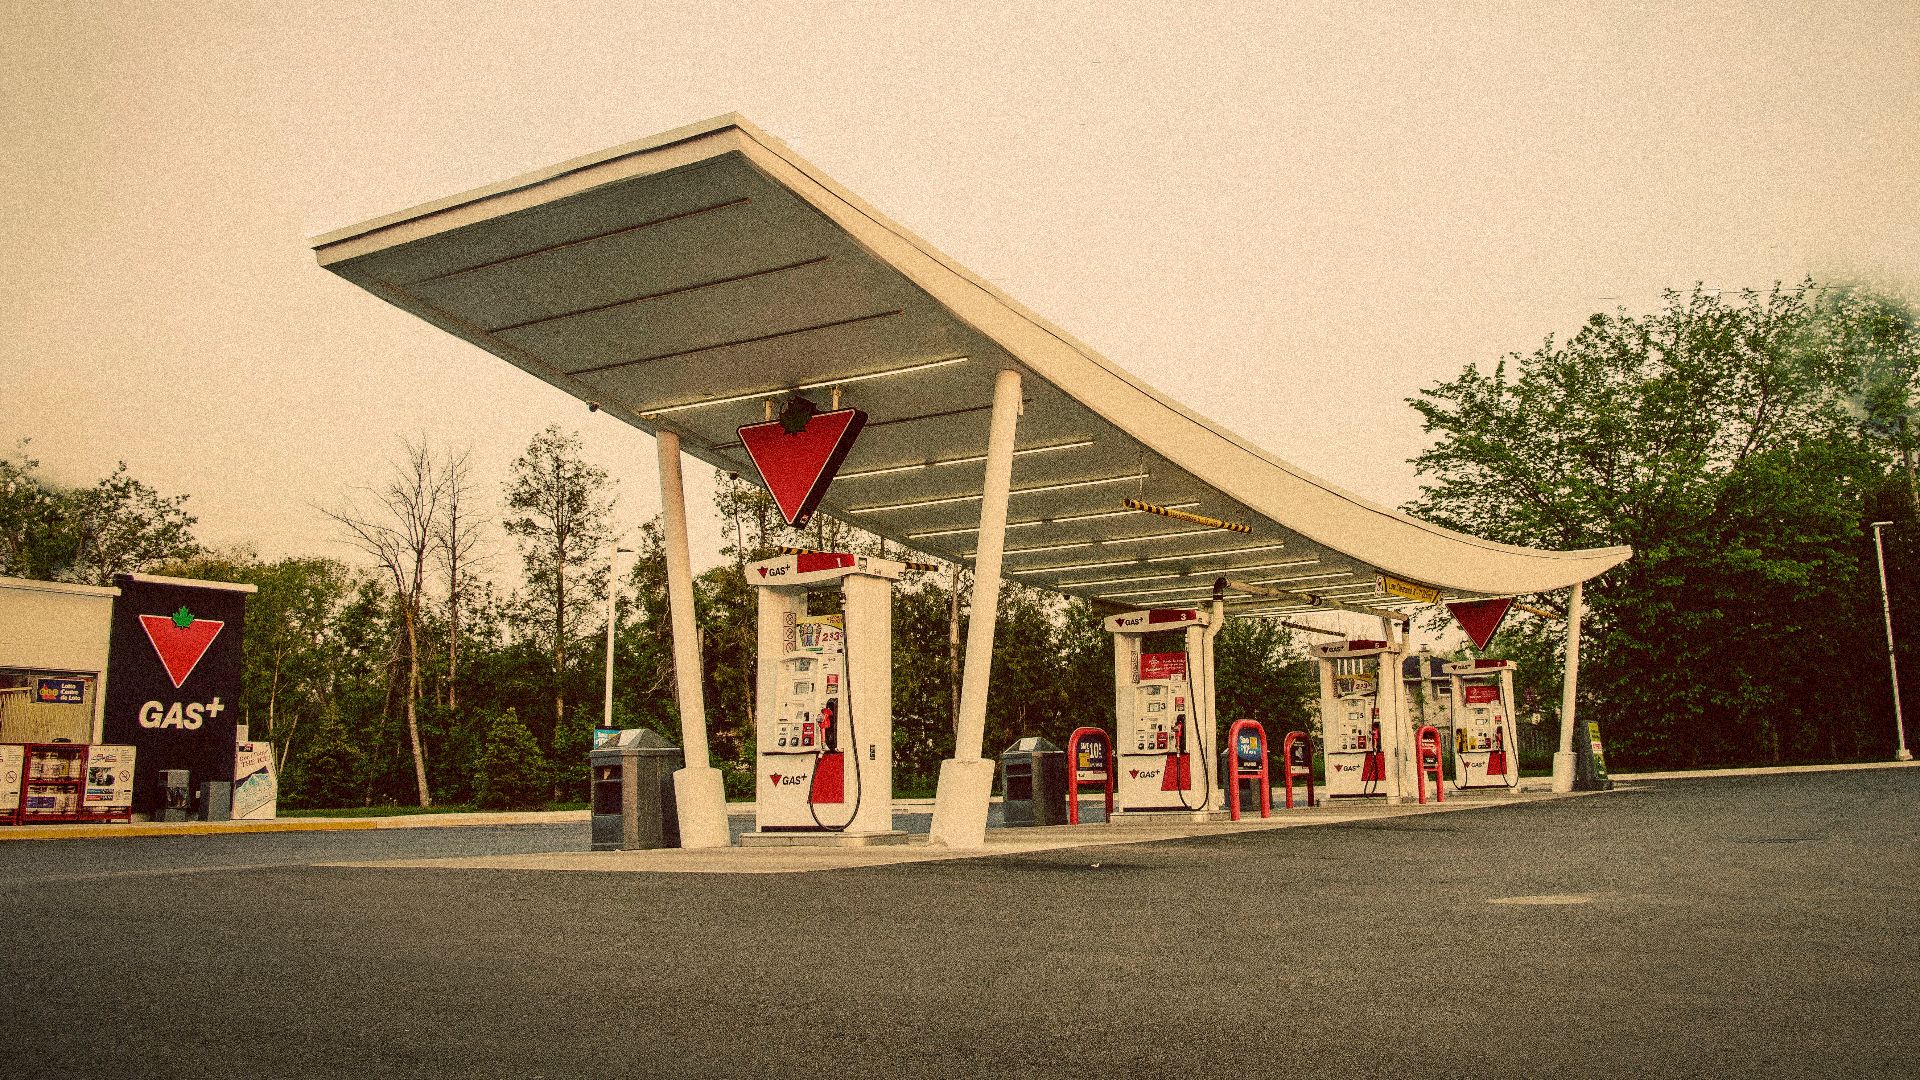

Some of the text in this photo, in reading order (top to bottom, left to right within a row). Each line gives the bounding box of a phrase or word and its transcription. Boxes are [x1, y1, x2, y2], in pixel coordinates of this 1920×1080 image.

[837, 557, 842, 568] 1
[769, 563, 791, 577] GAS+
[1125, 616, 1144, 626] GAS+
[1180, 613, 1186, 621] 3
[138, 696, 225, 730] GAS+
[1343, 763, 1361, 772] GAS+
[1139, 769, 1160, 779] GAS+
[782, 773, 808, 786] GAS+
